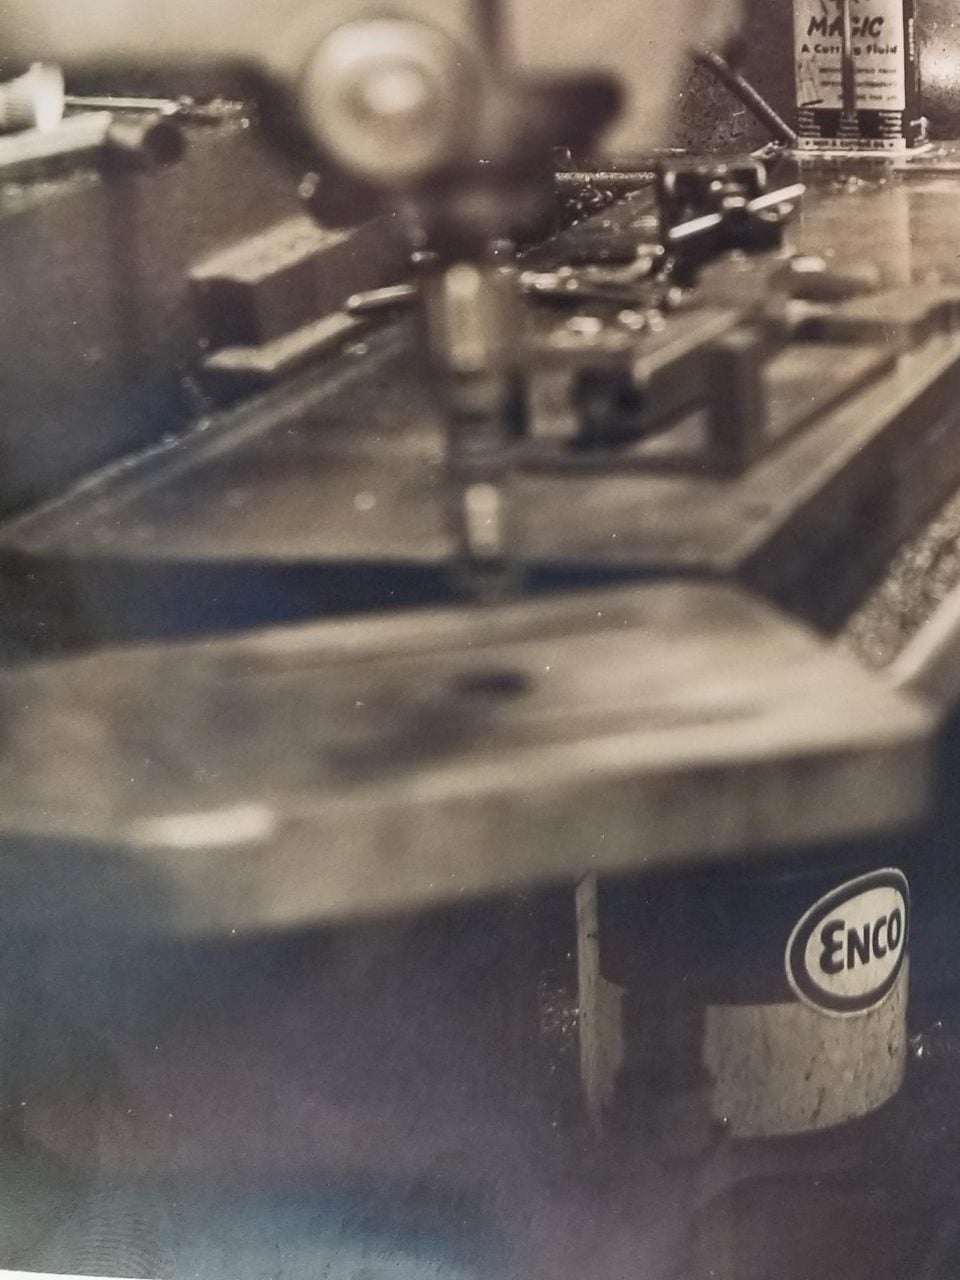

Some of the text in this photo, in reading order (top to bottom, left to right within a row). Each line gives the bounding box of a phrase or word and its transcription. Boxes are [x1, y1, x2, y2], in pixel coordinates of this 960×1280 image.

[801, 43, 898, 57] A Cuttg Fluid
[819, 907, 901, 976] ENCO
